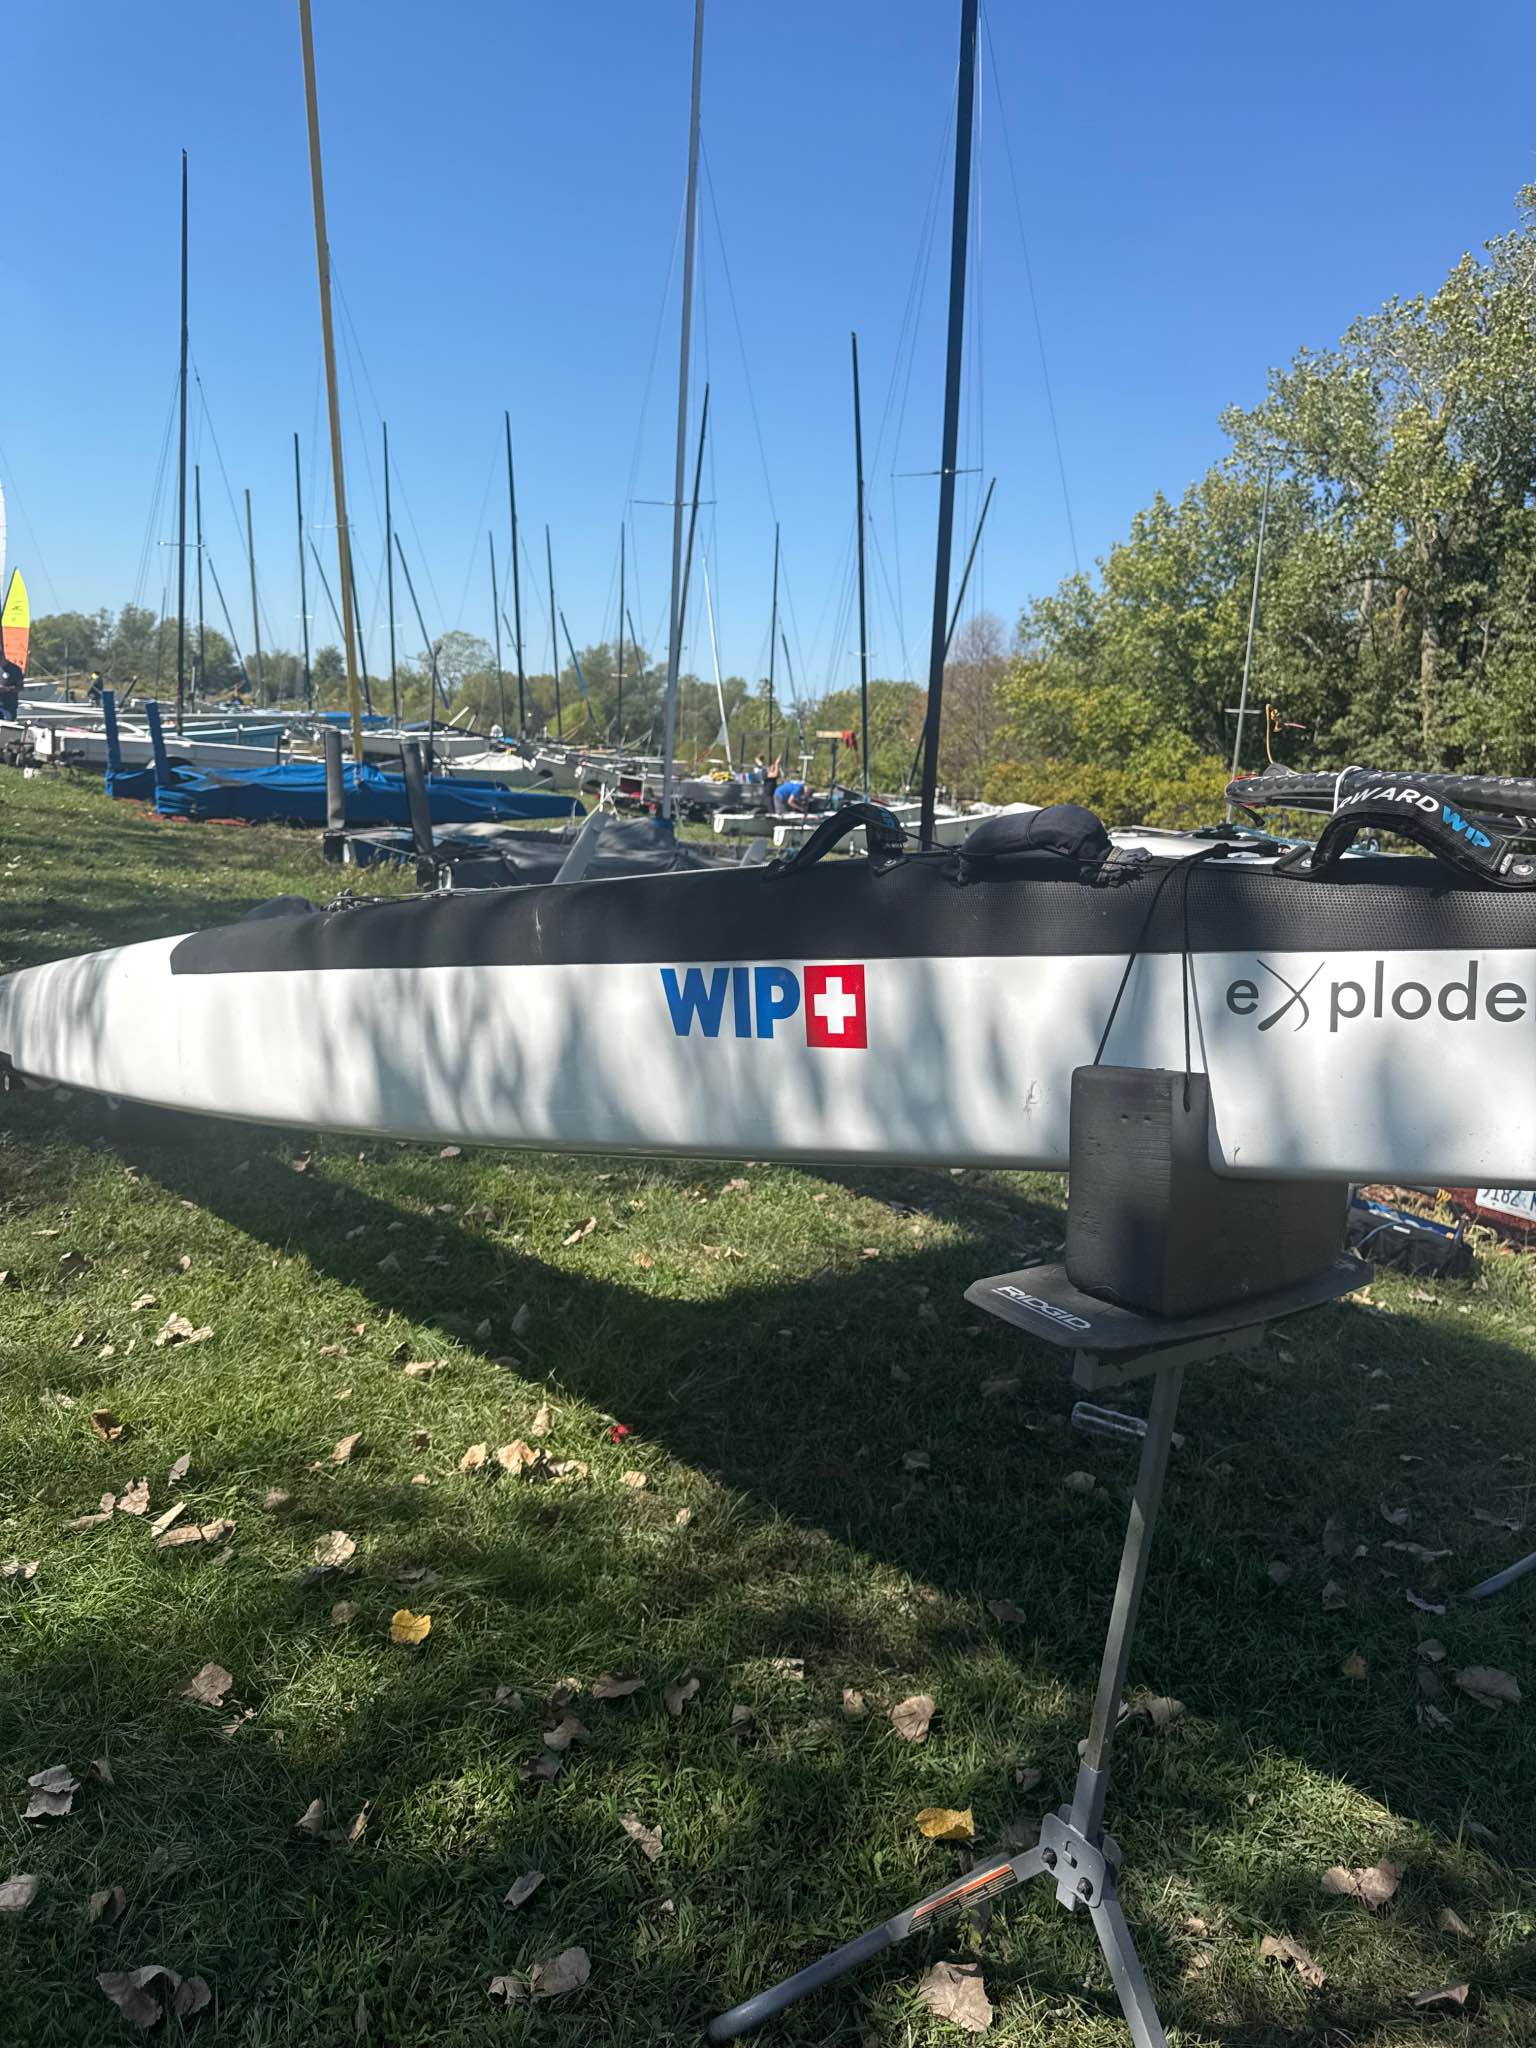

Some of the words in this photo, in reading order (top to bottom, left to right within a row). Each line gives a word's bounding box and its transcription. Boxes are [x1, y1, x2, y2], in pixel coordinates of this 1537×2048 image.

[1442, 805, 1492, 848] WIP
[660, 966, 801, 1039] WIP
[992, 1285, 1092, 1331] RIDGID
